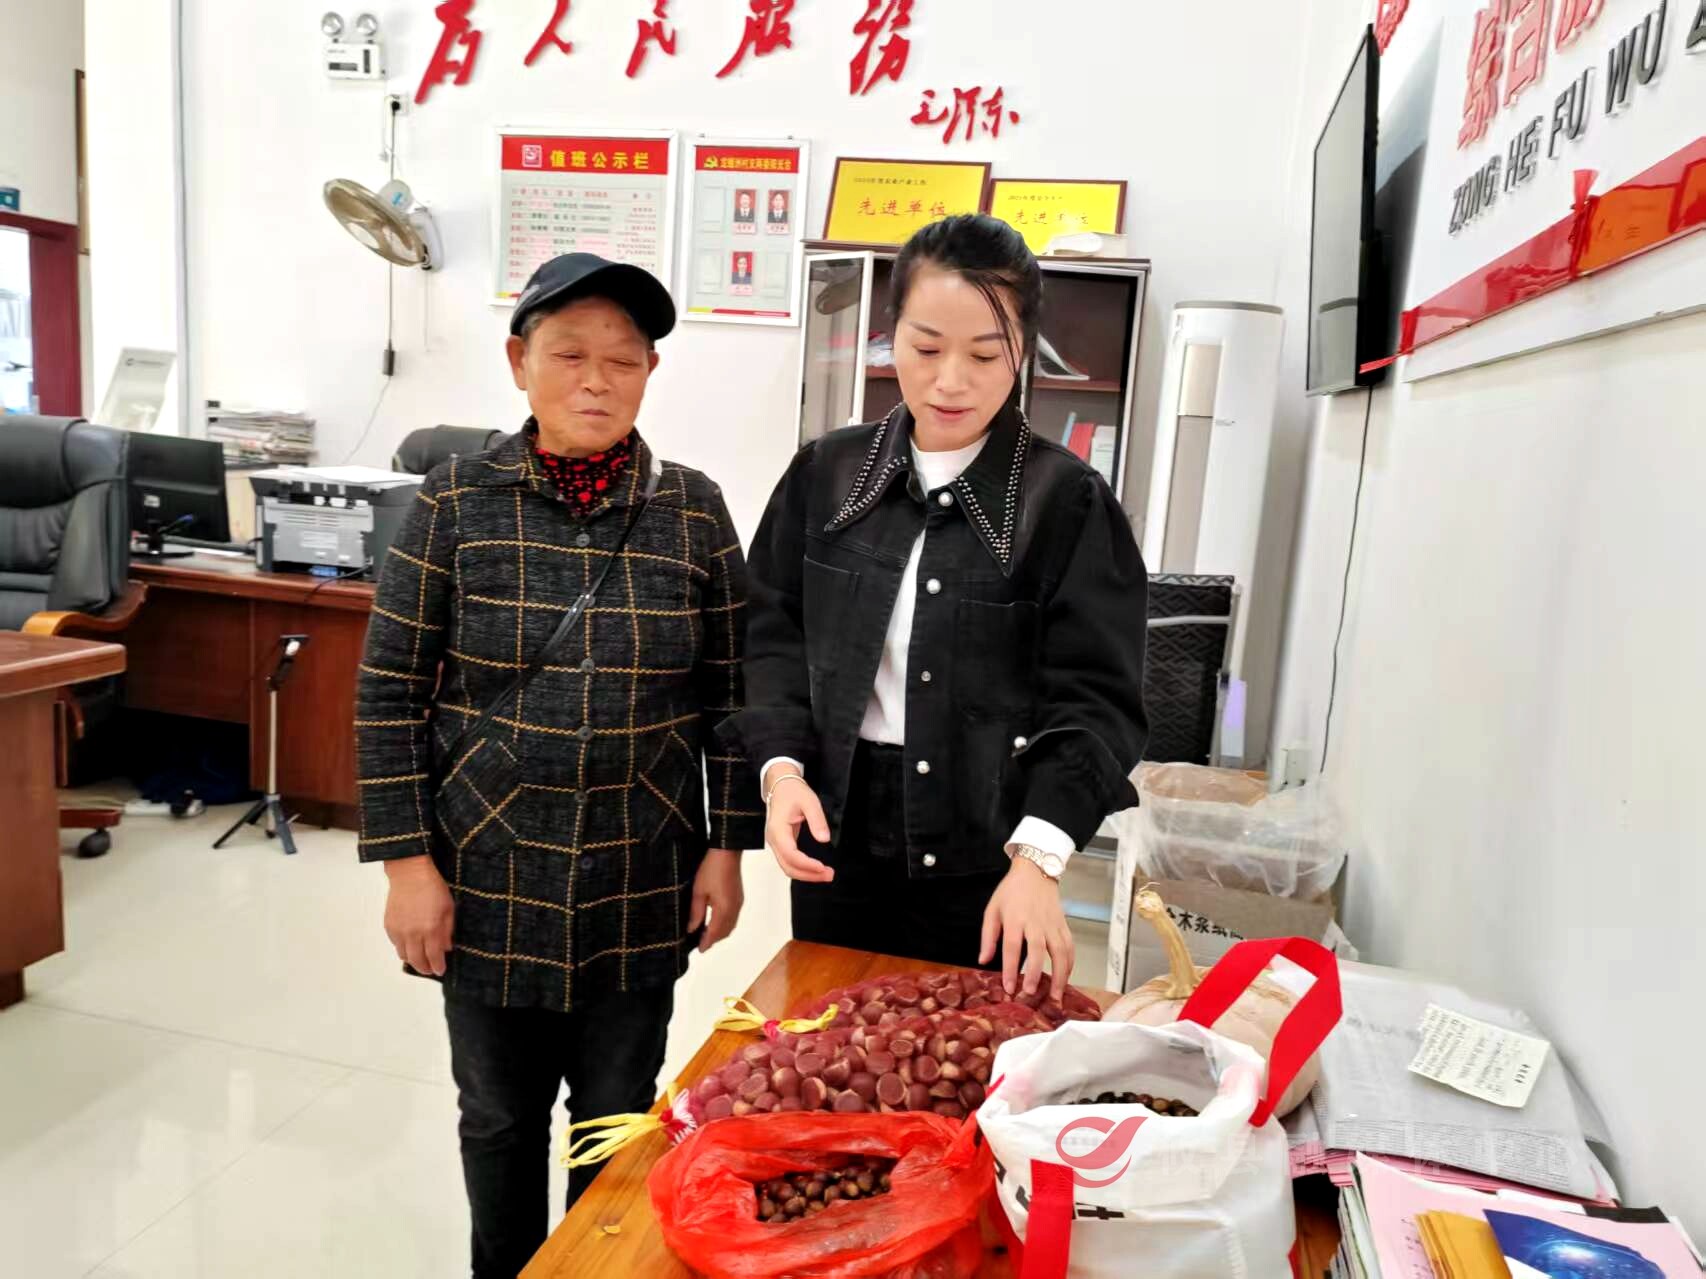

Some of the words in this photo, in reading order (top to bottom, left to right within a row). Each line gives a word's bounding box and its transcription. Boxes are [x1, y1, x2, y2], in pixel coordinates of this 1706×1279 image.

[1448, 154, 1502, 235] ZONG
[1503, 115, 1544, 192] HE
[1548, 65, 1598, 159] FU
[1604, 0, 1670, 115] WU
[549, 149, 650, 170] 值班公示栏
[856, 197, 947, 218] 先进单位
